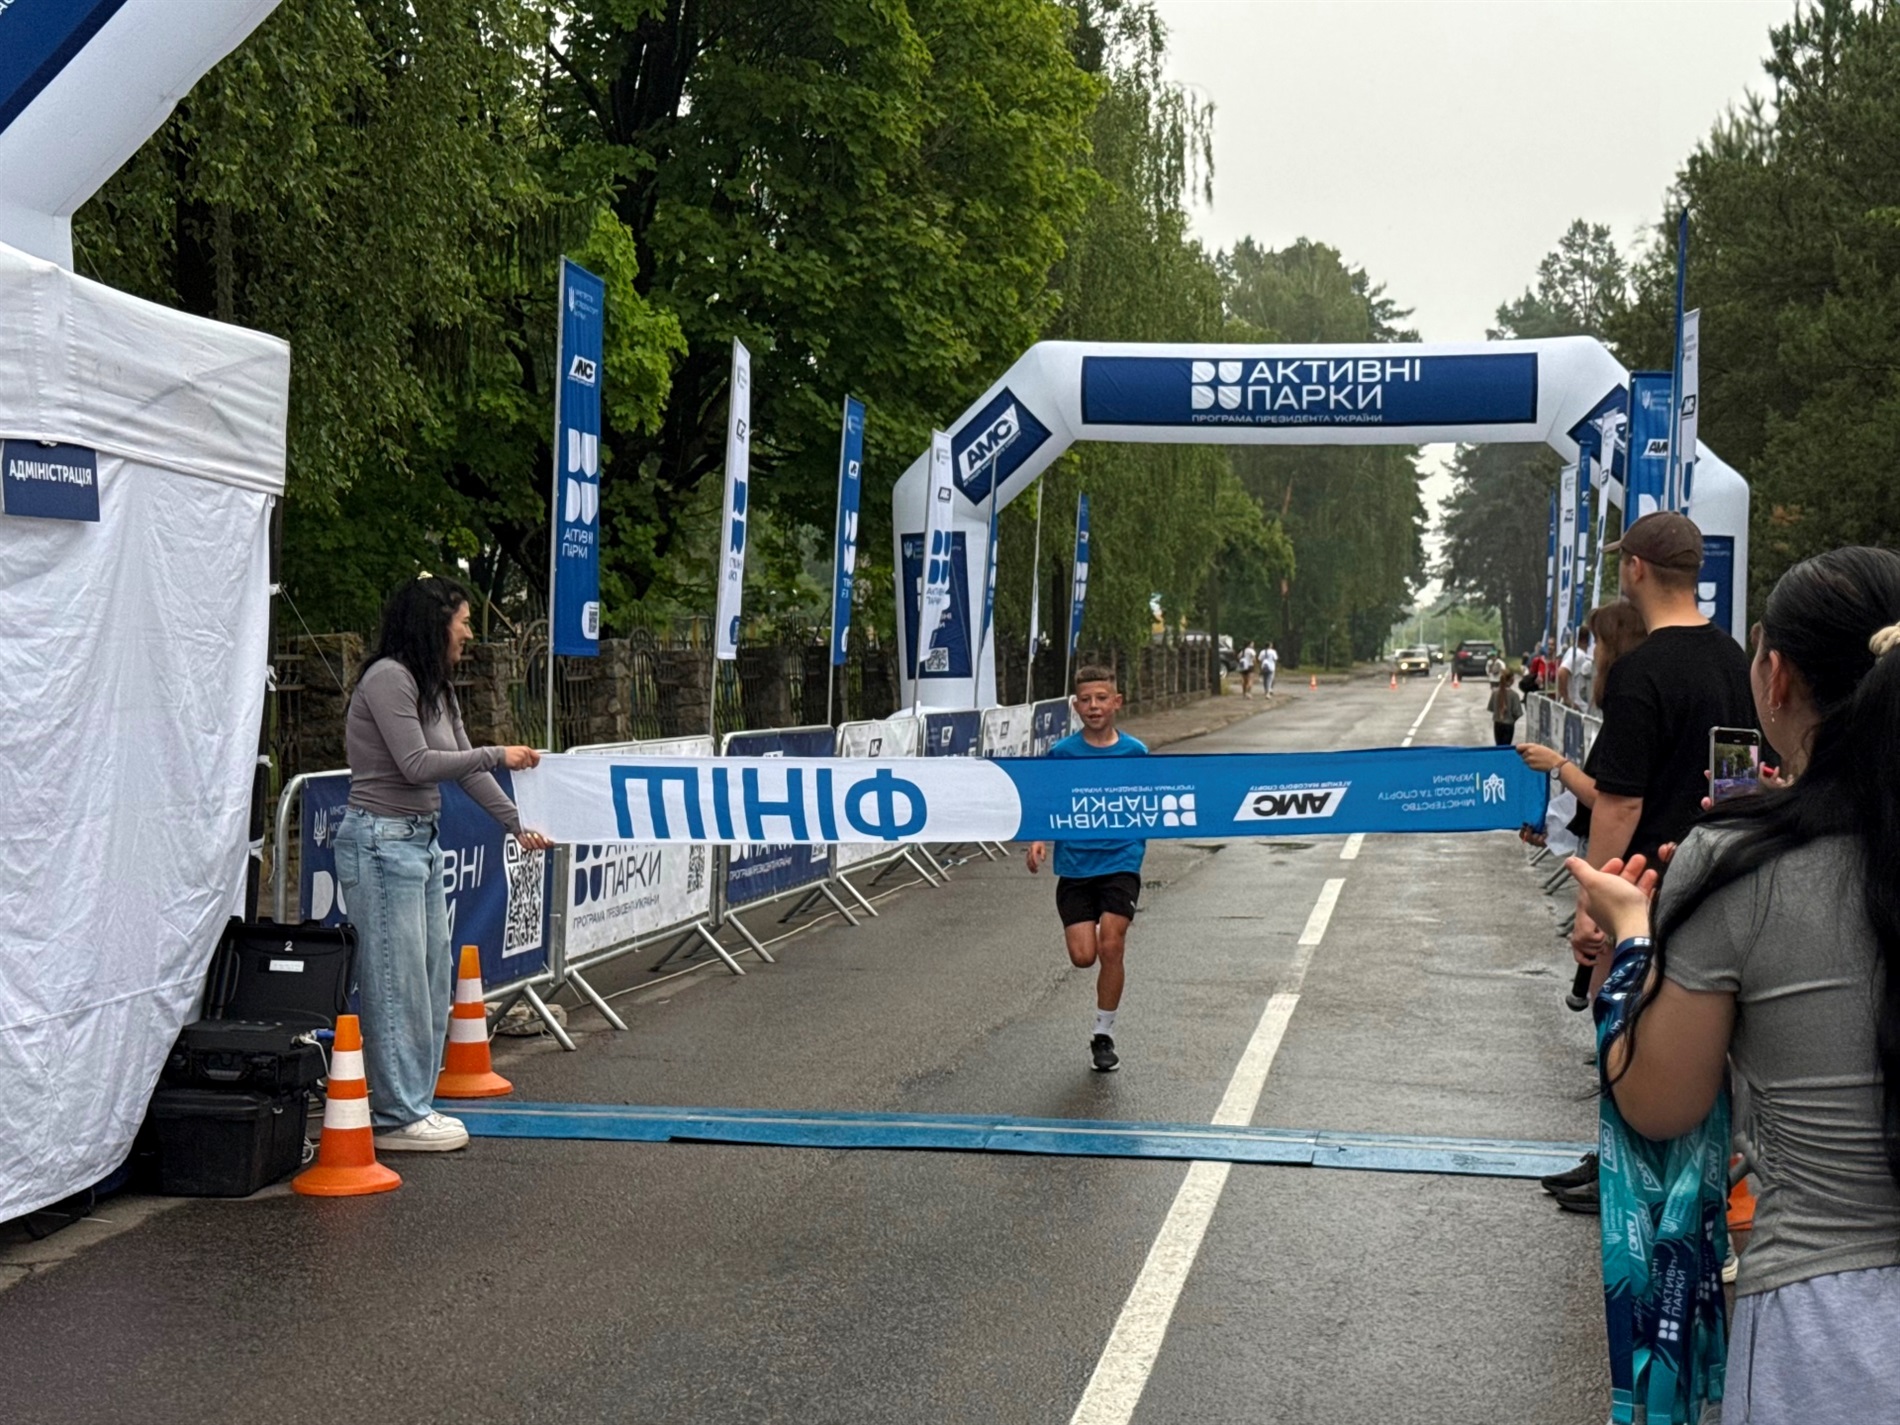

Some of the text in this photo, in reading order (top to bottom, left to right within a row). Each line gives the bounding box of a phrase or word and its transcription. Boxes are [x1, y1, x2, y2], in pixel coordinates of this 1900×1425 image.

[1247, 358, 1420, 383] АКТИВНІ
[1247, 384, 1382, 410] ПАРКИ
[1192, 413, 1383, 424] ПРОГРАМА ПРЕЗИДЕНТА УКРАЇНИ
[967, 419, 1012, 471] АМС
[9, 459, 92, 487] АДМІНІСТРАЦІЯ
[1249, 780, 1352, 791] АГЕНЦІЯ МАСОВОГО СПОРТУ
[1433, 772, 1475, 784] УКРАЇНИ
[1071, 784, 1195, 793] ПРОГРАМА ПРЕЗИДЕНТА УКРАЇНИ
[1377, 785, 1475, 801] МОЛОДІ ТА СПОРТУ
[609, 765, 927, 841] ФІНІШ
[1071, 795, 1158, 813] ПАРКИ
[1253, 792, 1331, 817] АМС
[1402, 798, 1475, 812] МІНІСТЕРСТВО
[1049, 812, 1159, 829] АКТИВНІ
[603, 850, 662, 899] ПАРКИ
[284, 941, 293, 951] 2
[1671, 1269, 1687, 1317] ПАРКИ
